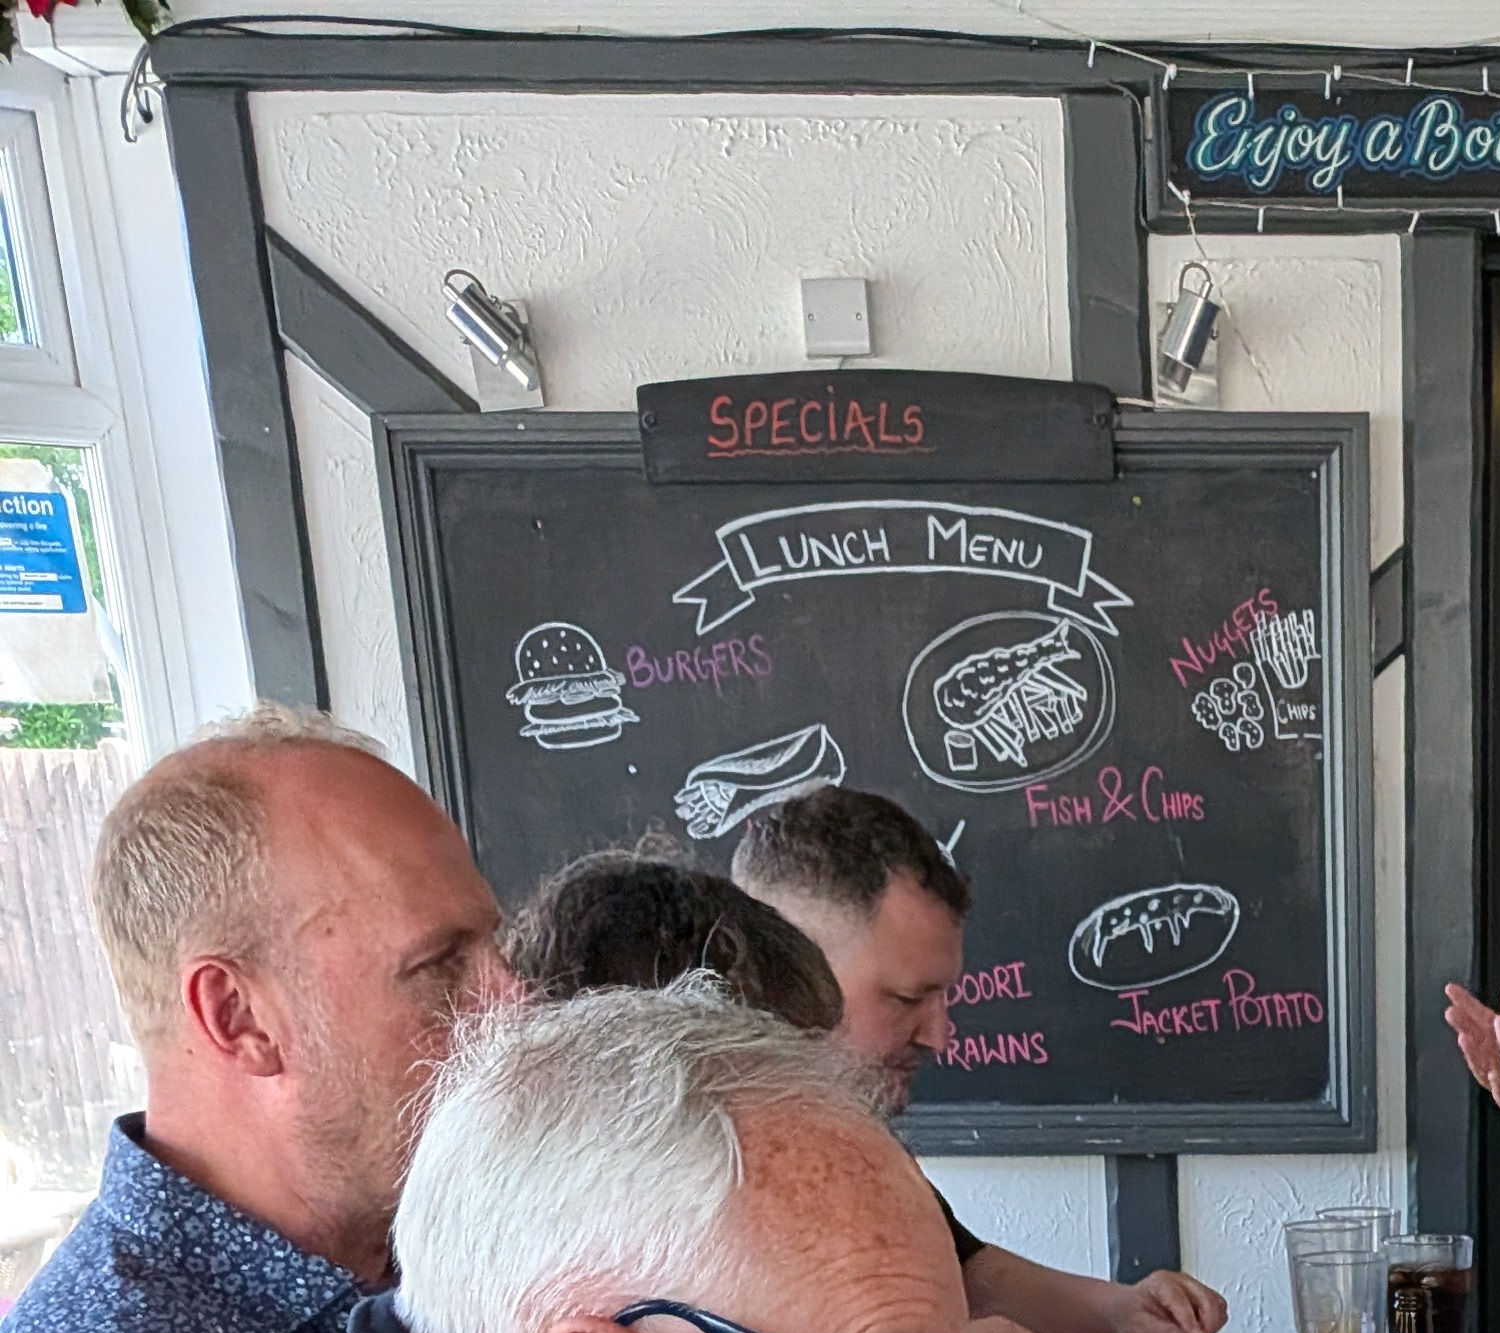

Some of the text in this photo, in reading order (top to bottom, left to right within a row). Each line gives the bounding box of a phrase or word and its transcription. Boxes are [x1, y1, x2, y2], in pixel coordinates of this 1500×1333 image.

[1197, 97, 1350, 189] Enjoy
[1365, 119, 1402, 163] a
[0, 494, 54, 516] ction
[750, 515, 1043, 578] LUNCH MENU
[625, 634, 773, 692] BURGERS
[1276, 699, 1317, 725] CHIPS
[1024, 766, 1205, 828] FISH & CHIPS
[1110, 968, 1325, 1035] JACKET POTATO
